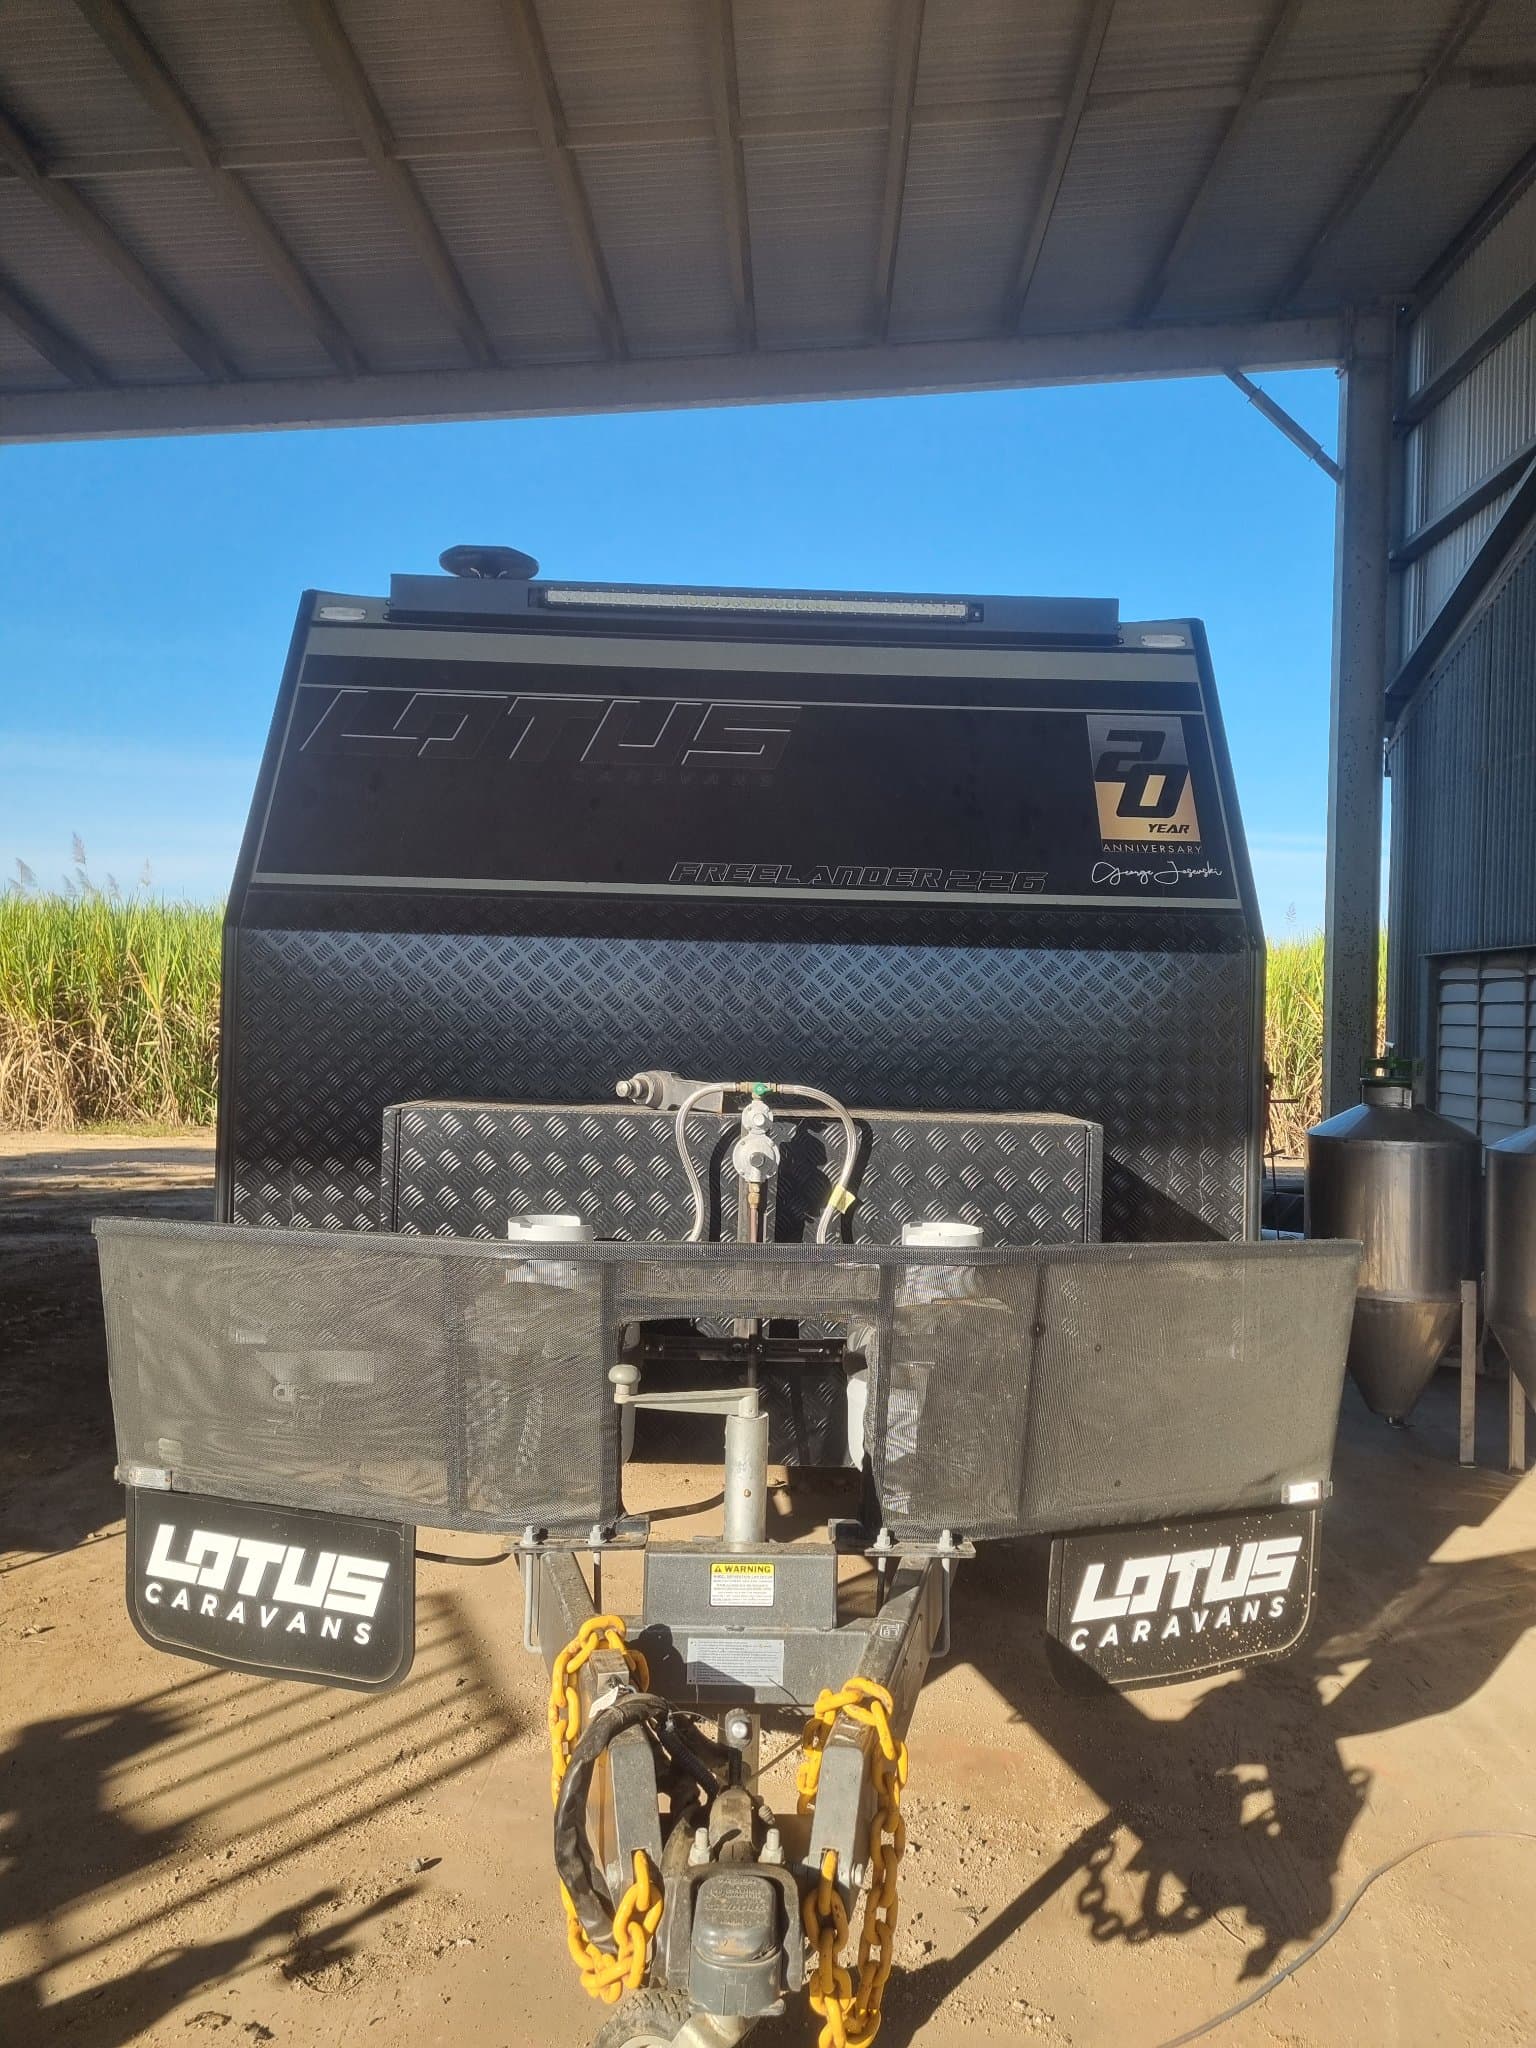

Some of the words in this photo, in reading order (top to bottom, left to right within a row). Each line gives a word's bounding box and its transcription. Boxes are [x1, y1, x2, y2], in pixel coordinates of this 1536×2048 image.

[300, 689, 803, 769] LOTUS
[1094, 729, 1190, 818] 20
[1103, 843, 1203, 854] ANNIVERSARY
[1148, 823, 1190, 834] YEAR
[668, 861, 943, 889] FREELANDER
[145, 1523, 390, 1618] LOTUS
[724, 1565, 772, 1574] WARNING
[1071, 1536, 1303, 1623] LOTUS
[145, 1583, 372, 1646] CARAVANS
[1070, 1596, 1287, 1652] CARAVANS
